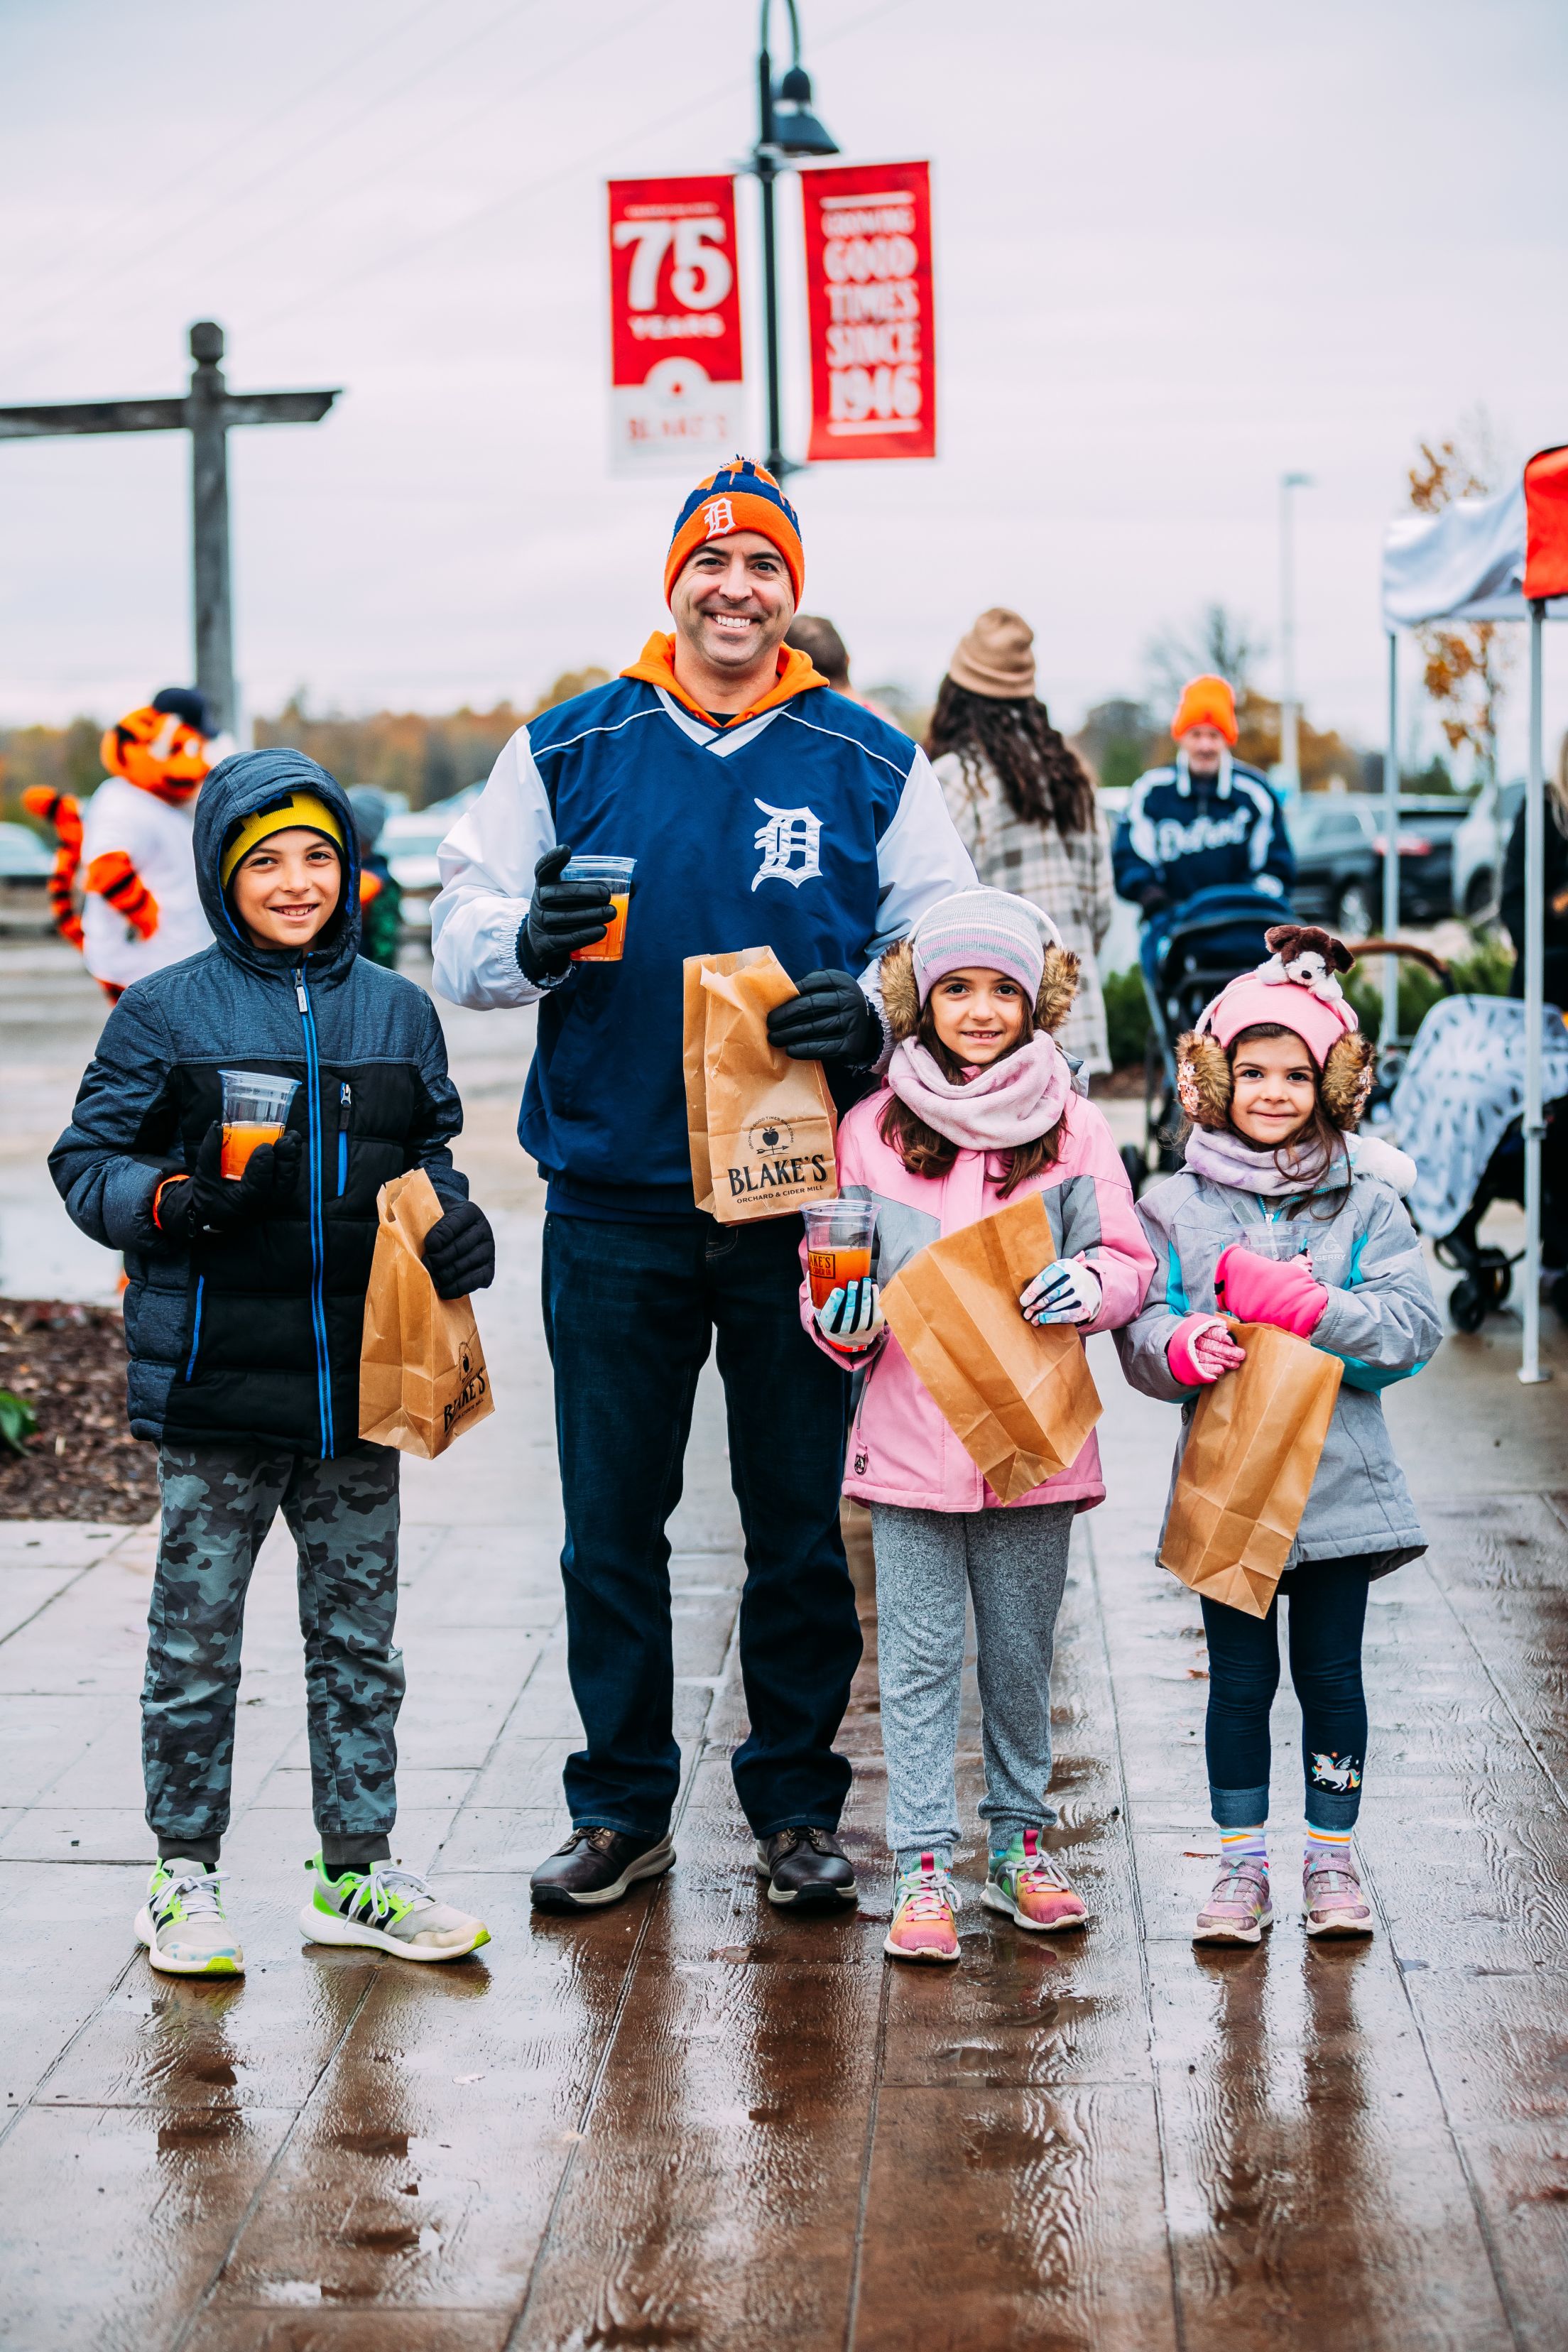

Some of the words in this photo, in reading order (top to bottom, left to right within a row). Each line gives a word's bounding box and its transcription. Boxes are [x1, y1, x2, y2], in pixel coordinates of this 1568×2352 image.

[612, 217, 733, 311] 75
[822, 236, 918, 282] GOOD
[824, 281, 920, 322] TIMES
[627, 313, 725, 340] YEARS
[827, 320, 922, 367] SINCE
[828, 367, 922, 421] 1946
[751, 797, 824, 892] D
[753, 1117, 765, 1128] GOOD
[727, 1154, 828, 1197] BLAKE'S
[736, 1193, 773, 1204] ORCHARD
